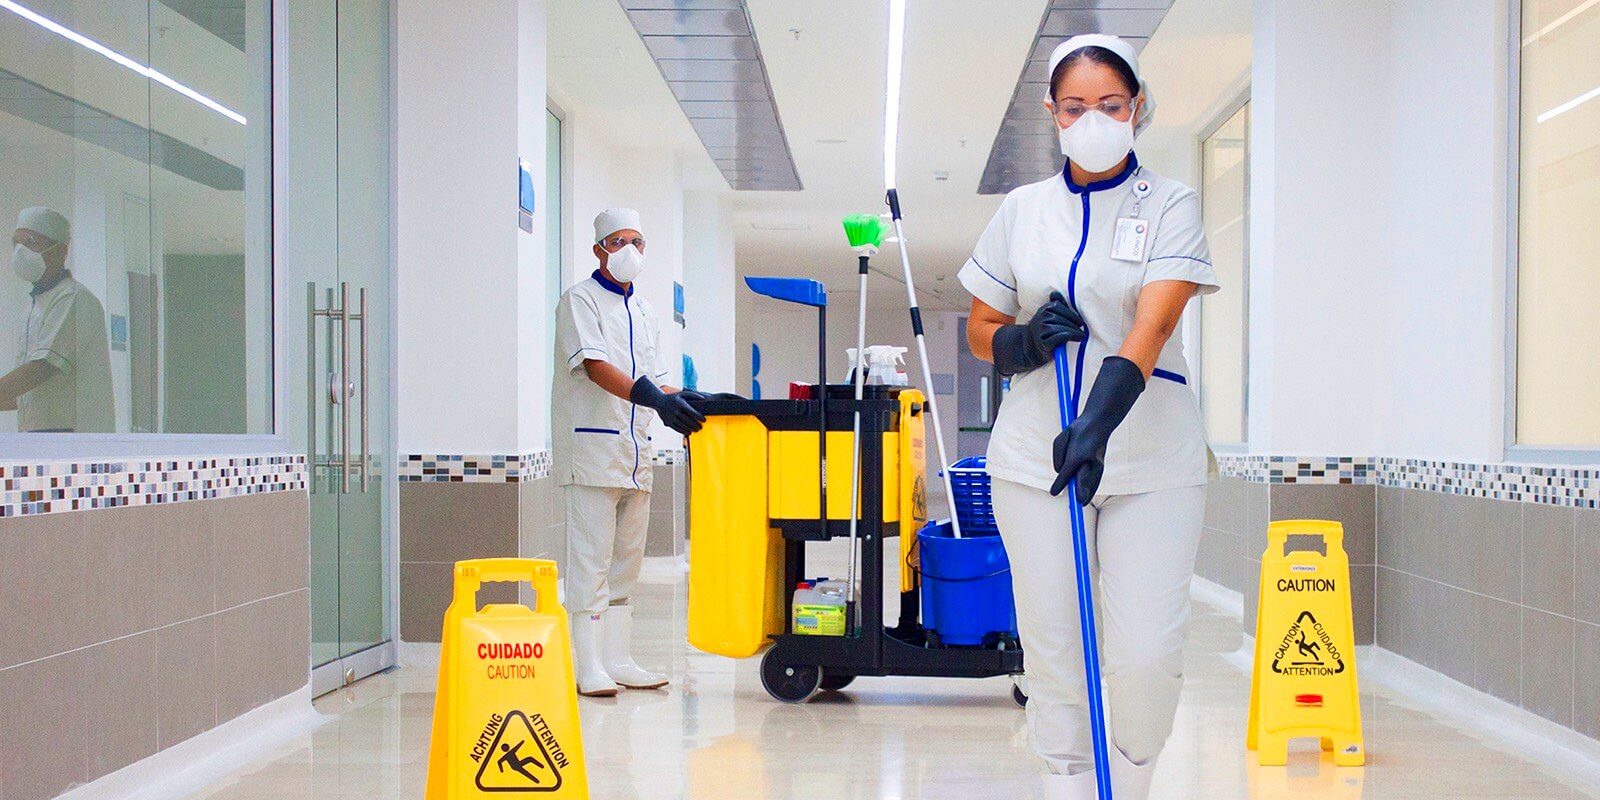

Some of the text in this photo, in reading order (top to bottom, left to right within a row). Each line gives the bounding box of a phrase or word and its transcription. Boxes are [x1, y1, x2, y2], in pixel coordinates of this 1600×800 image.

[1277, 579, 1335, 592] CAUTION
[478, 643, 543, 659] CUIDADO
[1275, 622, 1300, 660] CAUTION
[1313, 623, 1340, 660] CUIDADO
[487, 664, 535, 679] CAUTION
[1282, 667, 1334, 676] ATTENTION
[470, 713, 503, 763] ACHTUNG
[530, 713, 569, 769] ATTENTION
